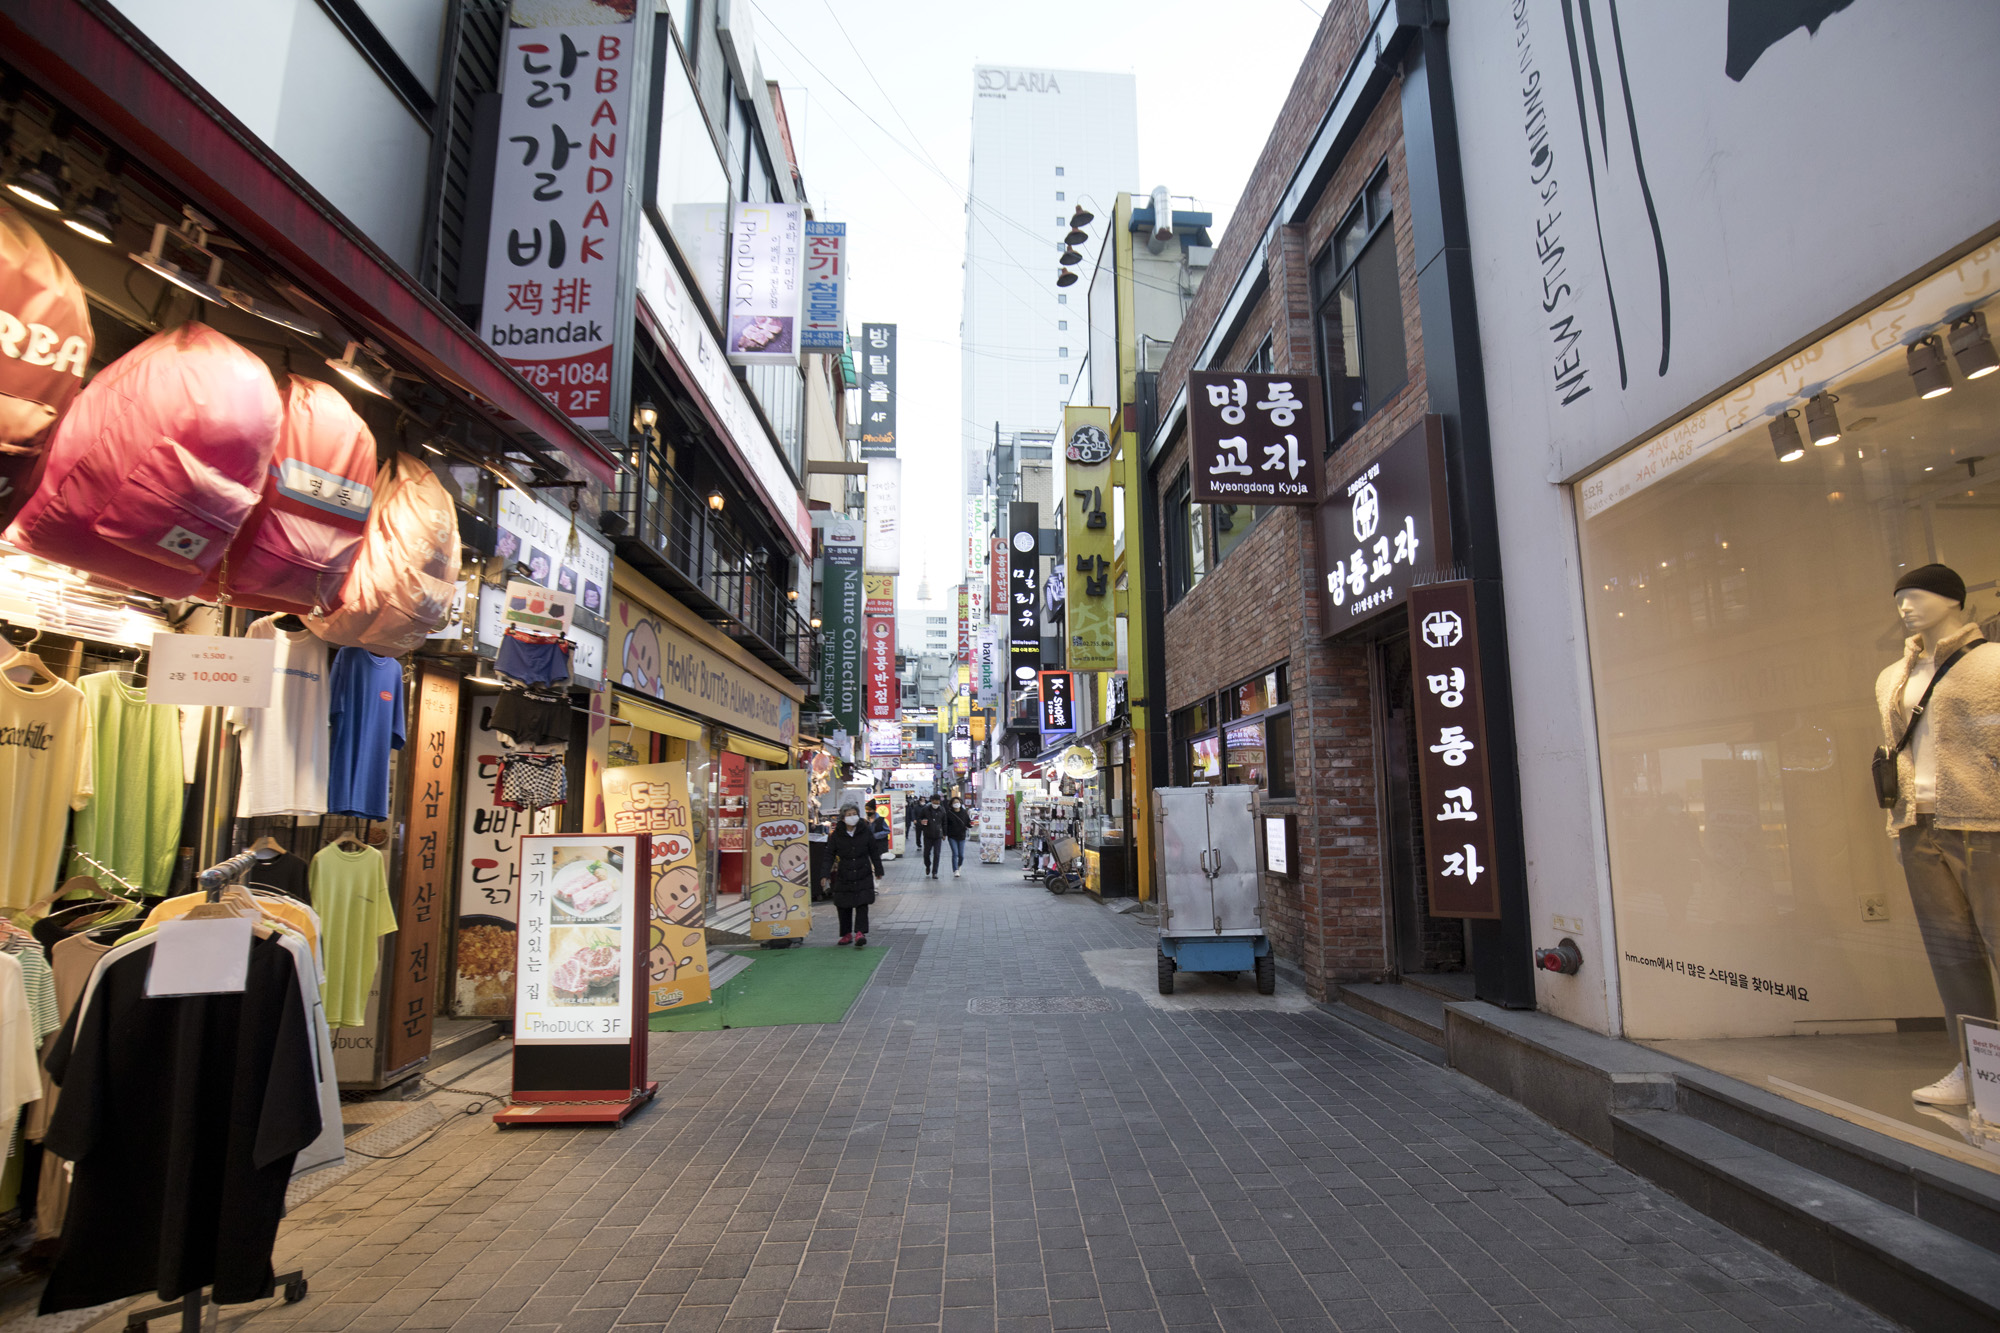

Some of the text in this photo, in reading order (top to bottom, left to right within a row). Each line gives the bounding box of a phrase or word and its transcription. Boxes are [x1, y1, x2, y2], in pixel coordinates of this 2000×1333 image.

[978, 69, 1061, 94] SOLARIA
[505, 33, 590, 270] 닭갈비
[580, 35, 621, 263] BBANDAK
[1543, 180, 1558, 206] IS
[805, 222, 846, 236] 서울전기
[735, 220, 757, 308] PhoDUCK
[504, 277, 592, 316] 鸡排
[491, 320, 603, 347] bbandak
[868, 328, 890, 402] 방탈출
[1550, 315, 1593, 407] NEW
[569, 390, 602, 411] 2F
[870, 412, 888, 422] 4F
[1206, 378, 1303, 427] 명동
[1072, 433, 1108, 459] 충무
[1208, 434, 1307, 481] 교자
[1210, 480, 1308, 495] Myeongdong Kyoja
[507, 500, 562, 554] PhoDUCK
[1074, 486, 1111, 596] 김밥
[975, 538, 983, 569] FOOD
[1327, 515, 1419, 607] 명동교자
[527, 588, 555, 602] SALE
[843, 569, 858, 624] Nature
[192, 671, 237, 682] 10,000
[841, 630, 858, 714] Collection
[873, 640, 889, 704] 홍콩반점
[982, 642, 993, 690] baviphat
[1051, 678, 1064, 690] K
[769, 782, 795, 802] 5봉
[1426, 667, 1484, 885] 명동교자
[630, 781, 671, 810] 5봉
[757, 801, 804, 817] 골라담기
[614, 806, 686, 833] 골라담기
[760, 824, 799, 838] 20,000
[403, 730, 447, 1039] 생삼겹살 전문
[525, 852, 546, 1001] 고기가 맛있는 집
[1625, 951, 1809, 1002] hm.com에서 더 많은 스타일을 찾아보세요
[533, 1019, 621, 1033] PhoDUCK 3F
[1973, 1038, 1988, 1048] Best
